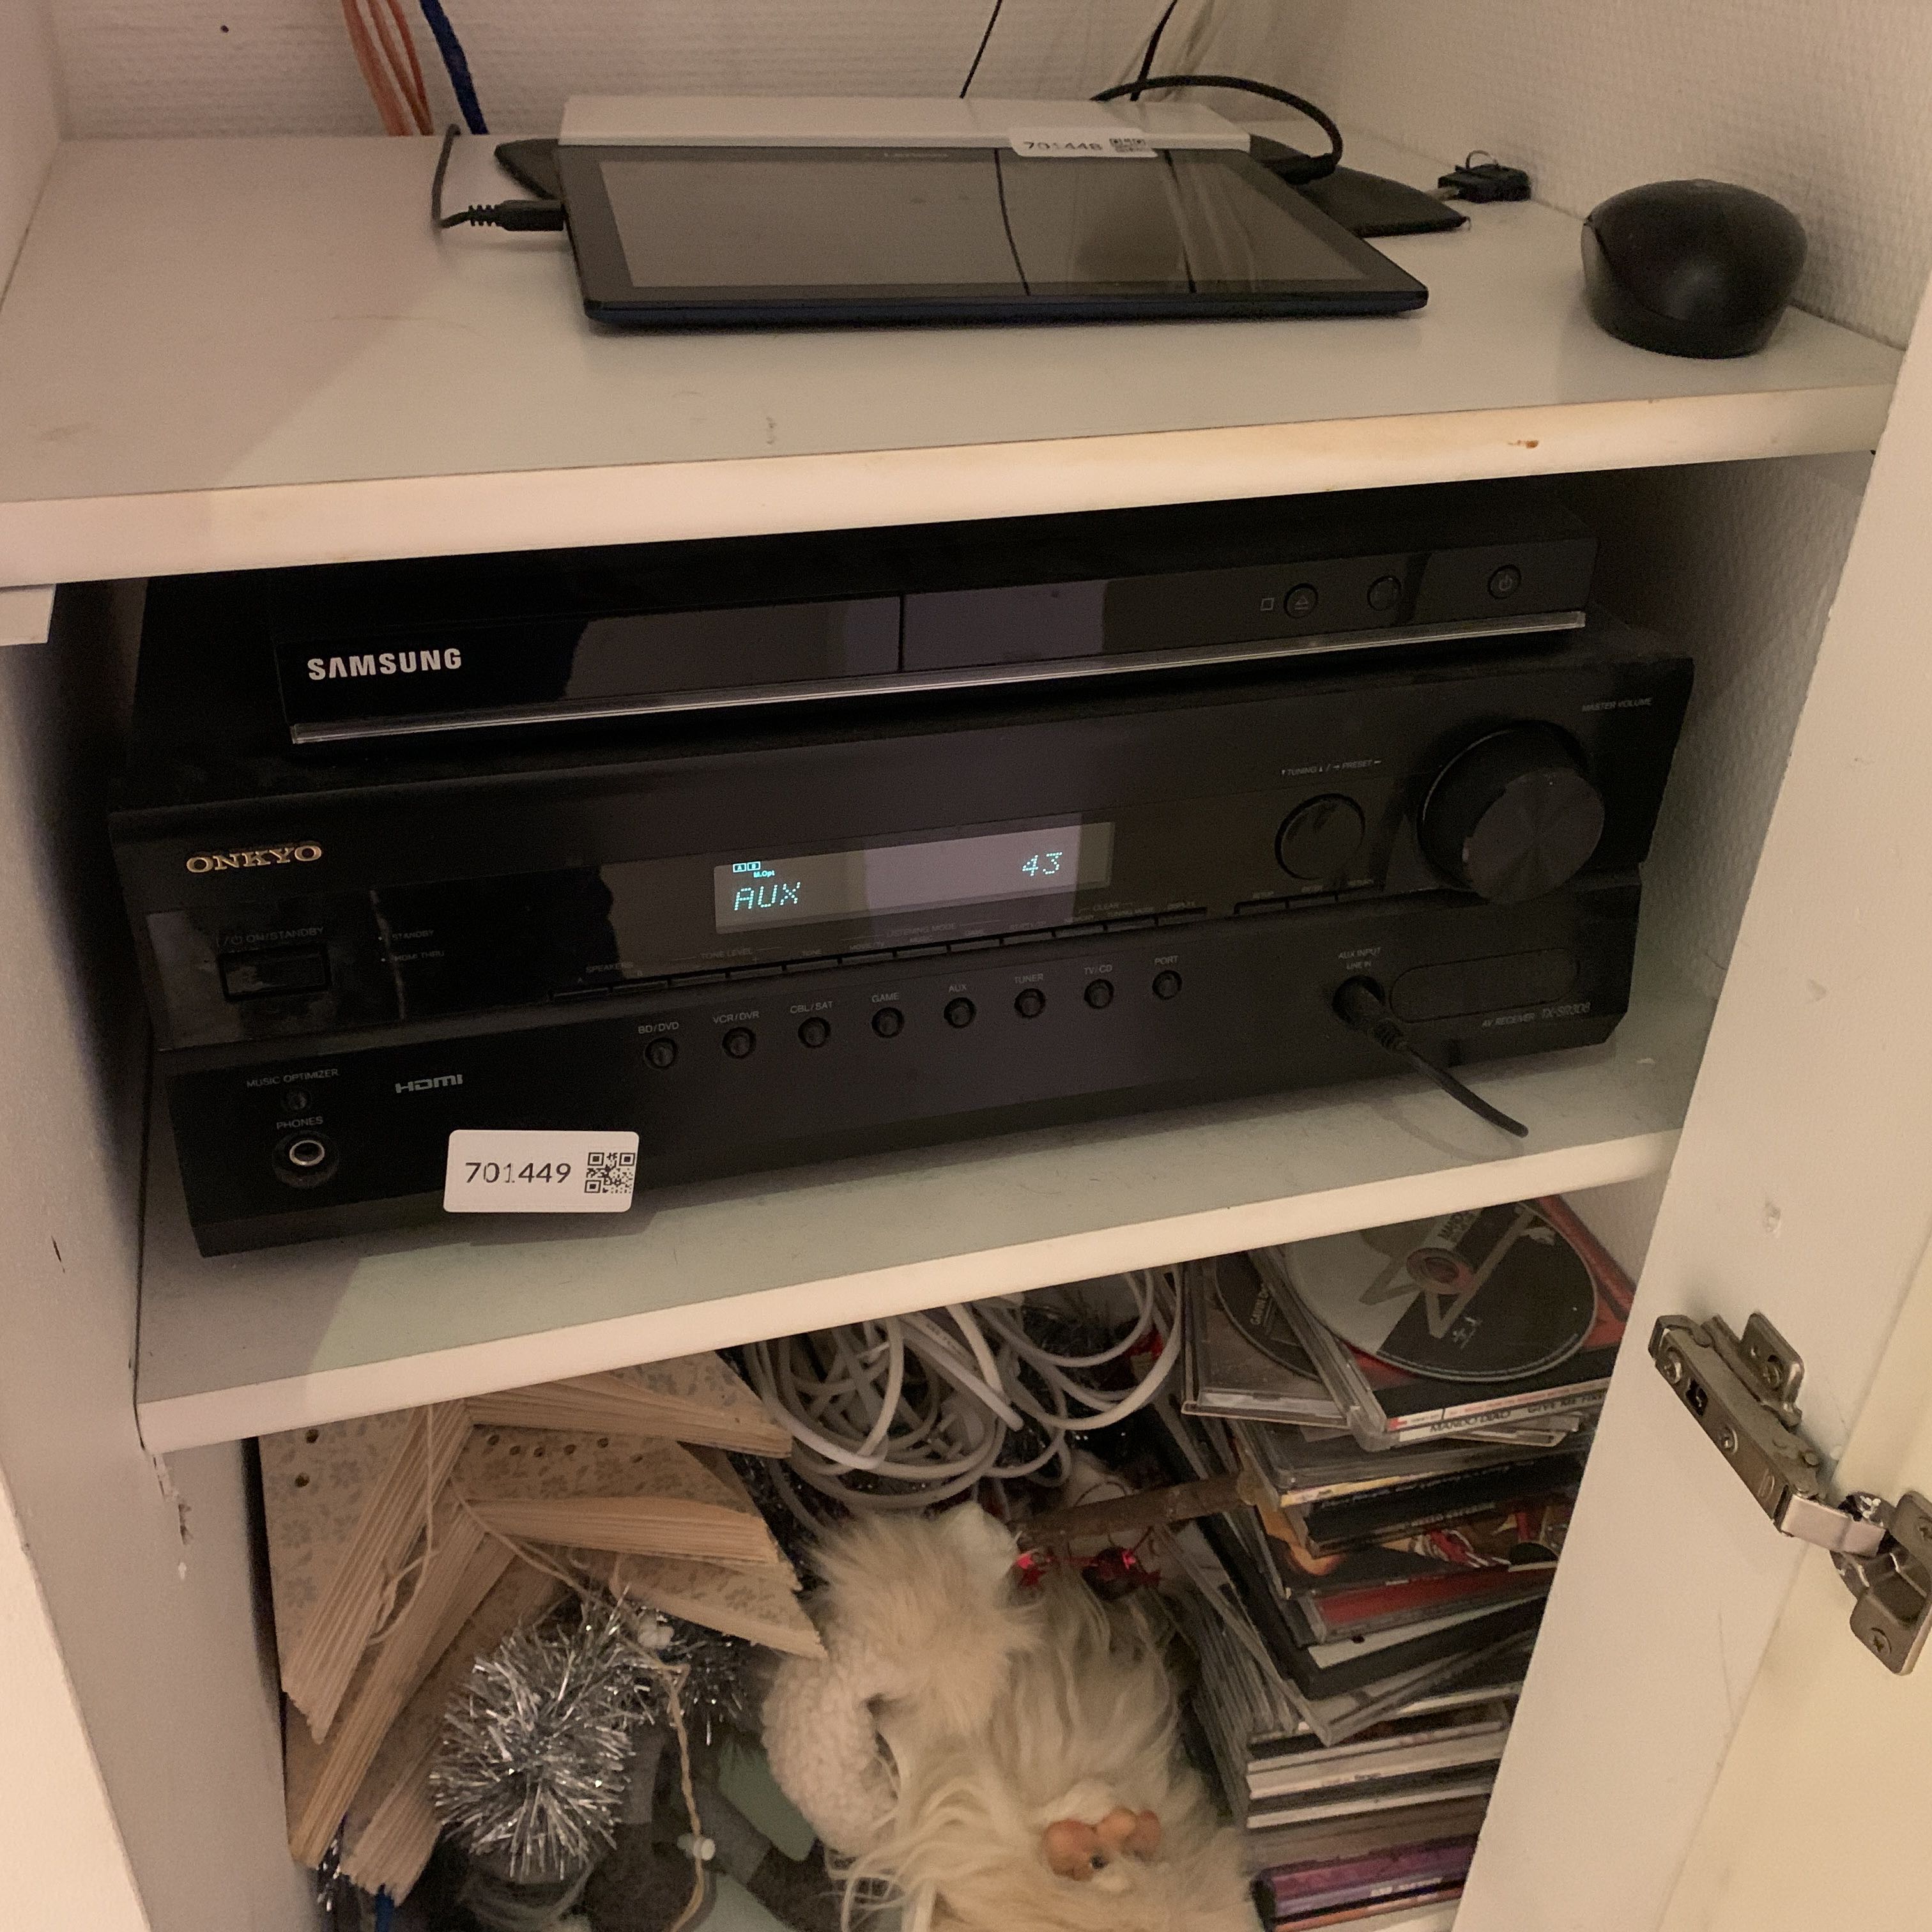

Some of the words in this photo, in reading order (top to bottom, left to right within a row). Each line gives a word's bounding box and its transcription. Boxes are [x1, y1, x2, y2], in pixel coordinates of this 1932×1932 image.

[307, 648, 461, 680] SAMSUNG
[186, 845, 322, 873] ONKYO
[1022, 852, 1062, 876] 43
[734, 882, 801, 910] AUX
[1154, 955, 1179, 965] PORT
[1015, 973, 1044, 985] TUNER
[948, 983, 967, 993] AUX
[871, 992, 900, 1004] GAME
[790, 1000, 834, 1015] CBL/SAT
[713, 1011, 760, 1024] VCR/DVR
[638, 1022, 680, 1035] BD/DVD
[246, 1077, 280, 1088] MUSIC
[283, 1068, 339, 1084] OPTIMIZER
[395, 1073, 464, 1094] HDMI
[276, 1116, 324, 1130] PHONES
[464, 1162, 571, 1183] 701449
